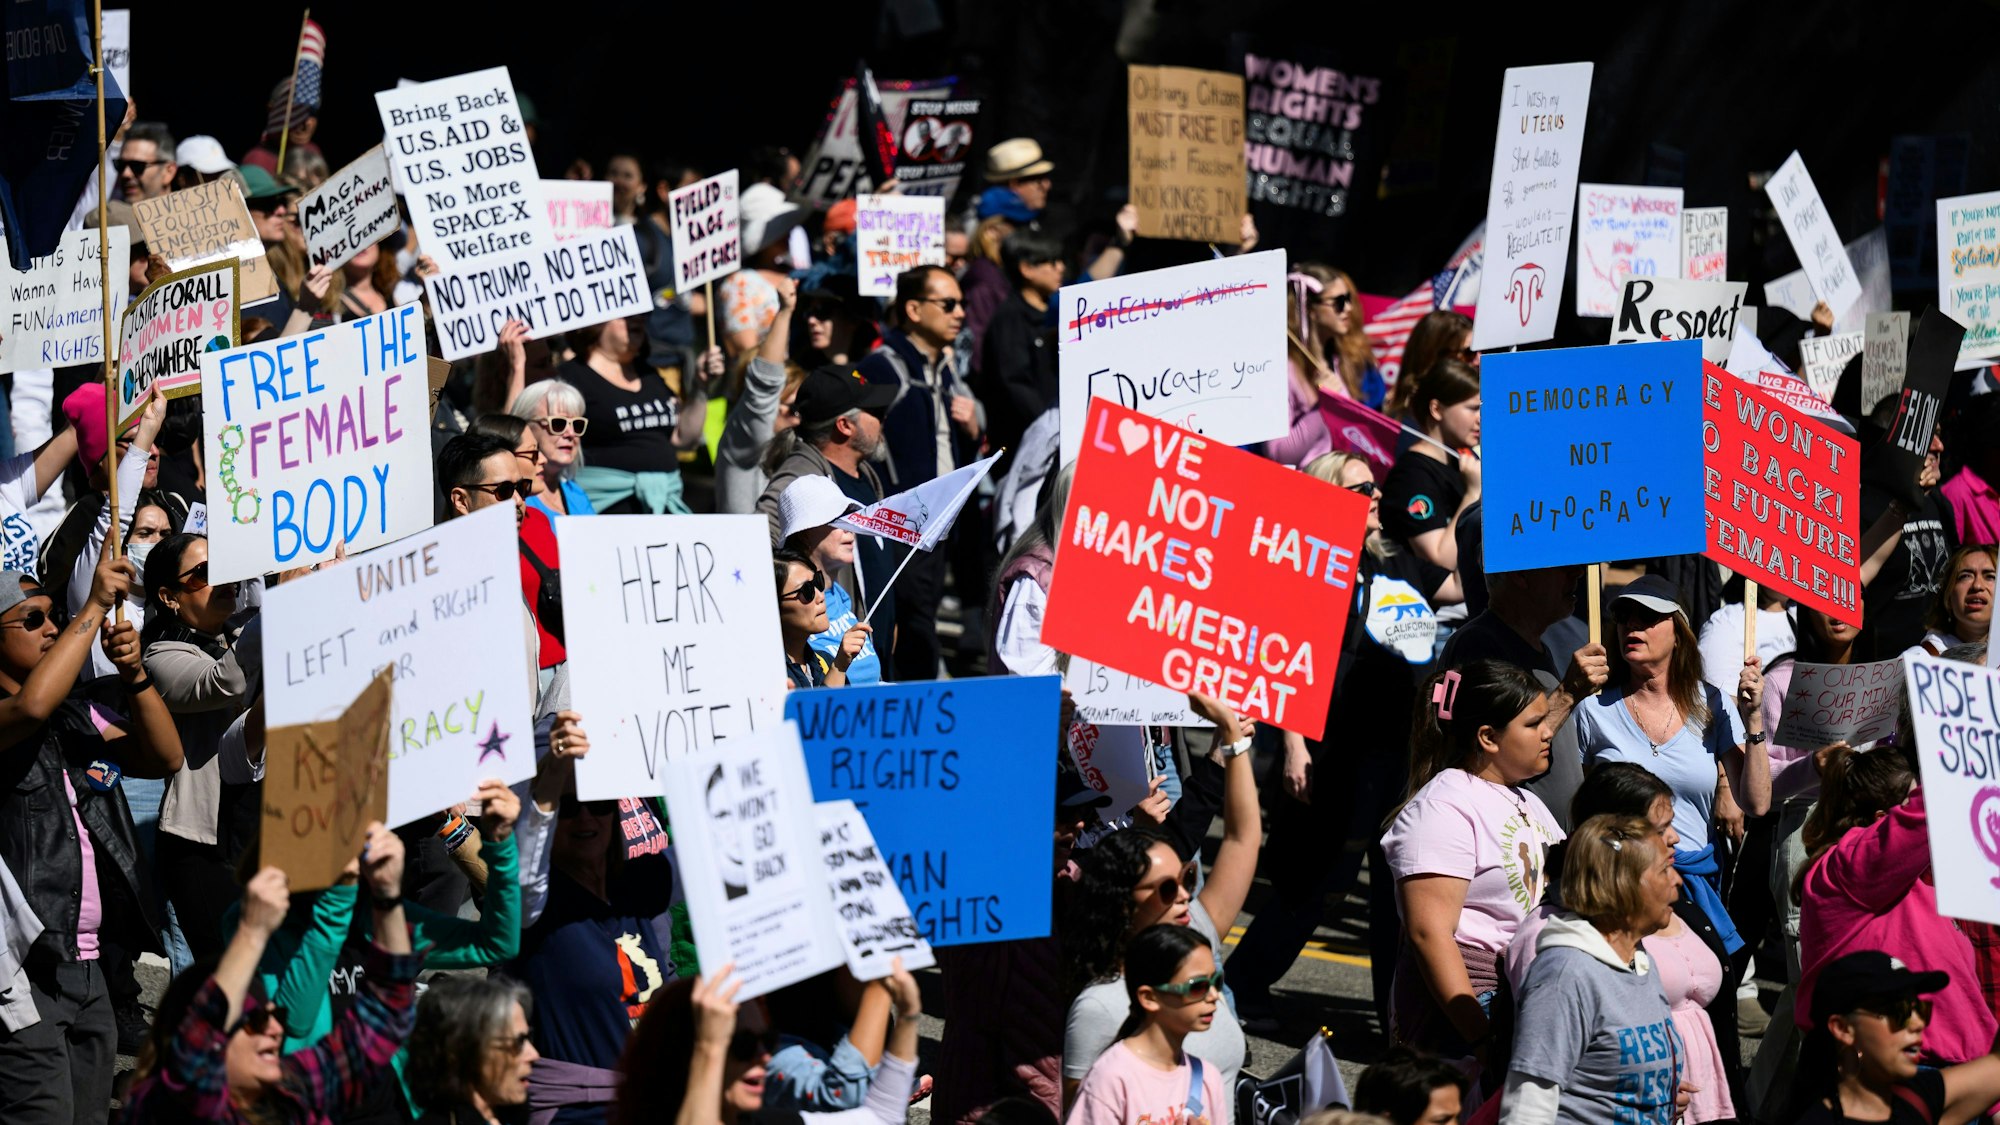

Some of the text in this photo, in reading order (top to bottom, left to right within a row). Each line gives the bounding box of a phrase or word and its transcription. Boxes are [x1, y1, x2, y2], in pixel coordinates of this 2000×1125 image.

[1244, 53, 1381, 103] WOMEN'S
[390, 87, 510, 128] Bring Back
[500, 114, 521, 135] &
[1178, 114, 1217, 143] RISE
[1222, 119, 1243, 146] UP
[1247, 85, 1363, 131] RIGHTS
[405, 142, 527, 185] U.S. JOBS
[1243, 141, 1355, 188] HUMAN
[150, 202, 220, 239] EQUITY
[426, 179, 522, 213] No More
[432, 200, 532, 238] SPACE-X
[446, 230, 533, 261] Welfare
[10, 281, 56, 303] Wanna
[433, 274, 466, 315] NO
[544, 247, 576, 285] NO
[11, 290, 119, 336] FUNdamentl
[138, 302, 203, 356] WOMEN
[444, 312, 487, 352] YOU
[554, 287, 585, 323] DO
[588, 272, 640, 313] THAT
[1617, 279, 1741, 342] Respect
[219, 306, 418, 422] FREE THE
[1760, 374, 1783, 389] we
[1785, 379, 1812, 397] are
[1508, 379, 1675, 415] DEMOCRACY
[1886, 387, 1940, 458] FELON
[249, 374, 404, 480] FEMALE
[1733, 388, 1847, 475] WON'T
[1569, 441, 1613, 467] NOT
[1740, 439, 1844, 524] BACK!
[271, 463, 391, 563] BODY
[1147, 476, 1354, 590] NOT HATE
[1510, 485, 1673, 537] AUTOCRACY
[1731, 478, 1856, 568] FUTURE
[355, 541, 441, 602] UNITE
[1071, 504, 1215, 591] MAKES
[616, 541, 725, 626] HEAR
[285, 575, 495, 687] LEFT and RIGHT
[1126, 584, 1315, 686] AMERICA
[1384, 620, 1435, 637] CALIFORNIA
[662, 643, 702, 696] ME
[1161, 647, 1298, 725] GREAT
[1823, 665, 1866, 688] OUR
[1912, 661, 1983, 724] RISE
[797, 690, 957, 741] WOMEN'S
[1811, 708, 1854, 726] OUR
[1817, 690, 1856, 709] OUR
[830, 746, 961, 791] RIGHTS
